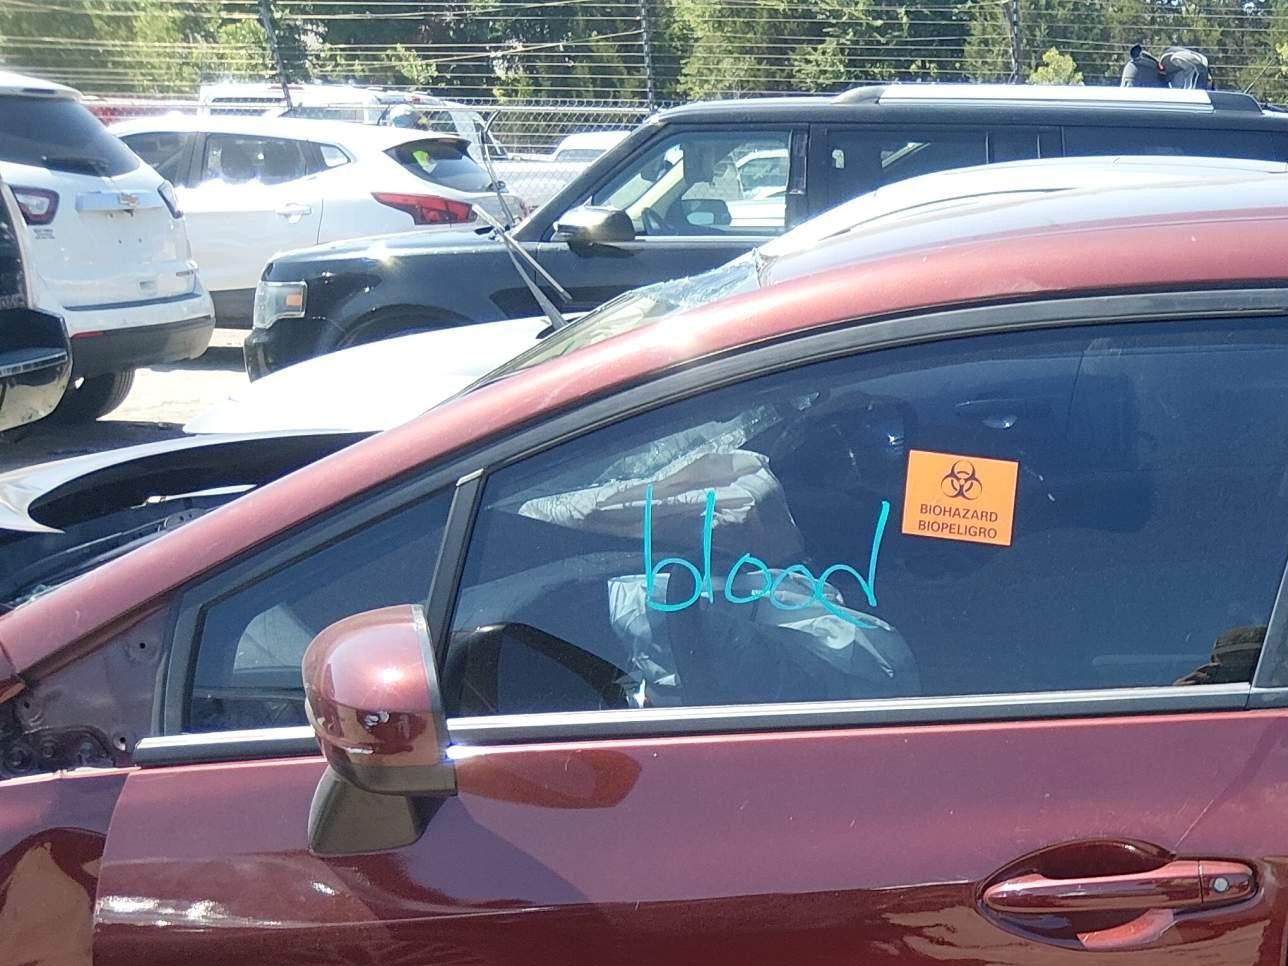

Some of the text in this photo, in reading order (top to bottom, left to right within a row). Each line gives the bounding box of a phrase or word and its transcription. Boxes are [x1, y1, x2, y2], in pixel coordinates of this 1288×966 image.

[920, 503, 998, 523] BIOHAZARD
[918, 519, 998, 539] BIOPELIGRO
[643, 484, 891, 629] blood
